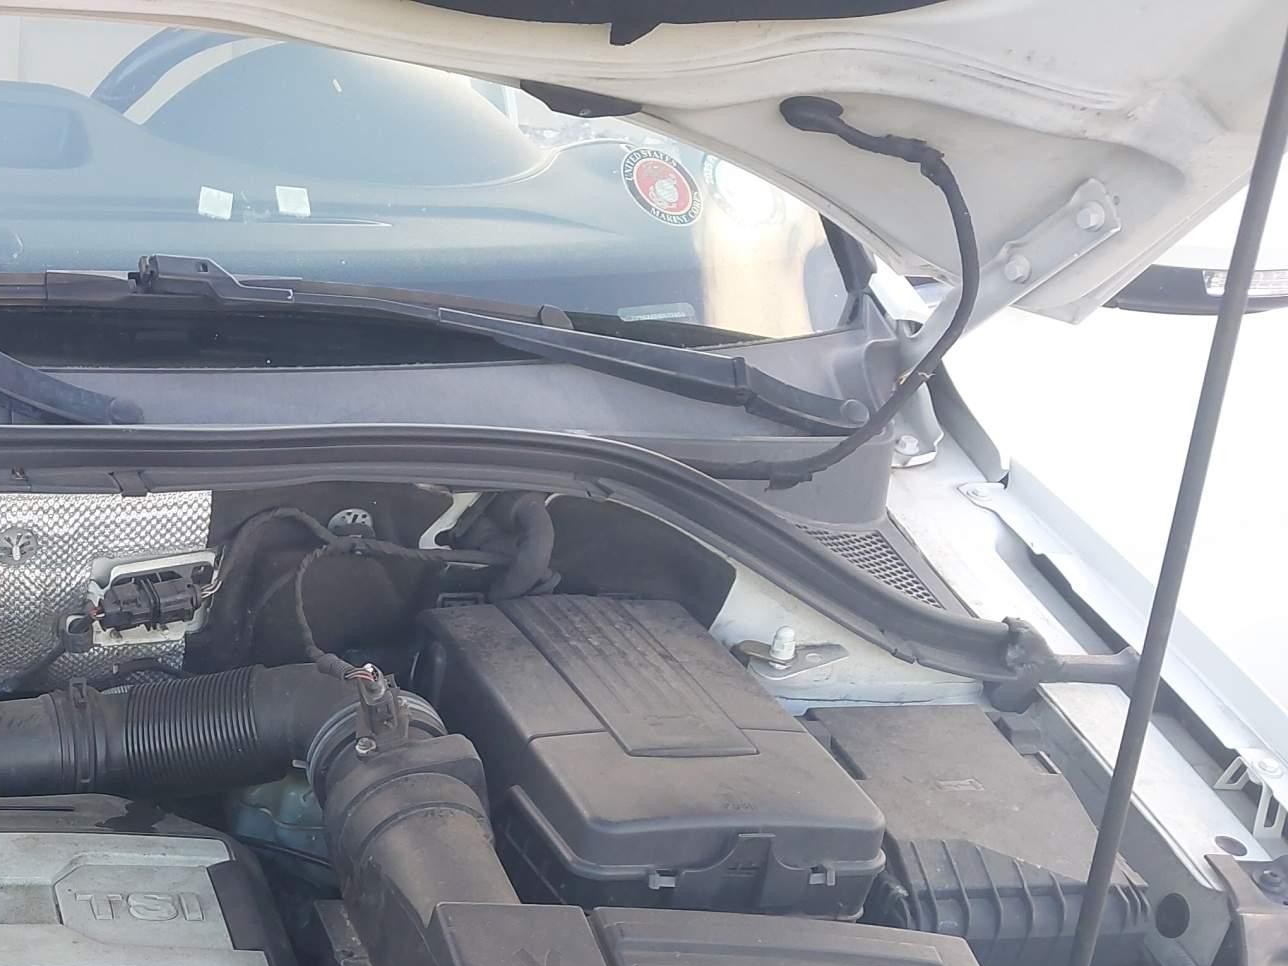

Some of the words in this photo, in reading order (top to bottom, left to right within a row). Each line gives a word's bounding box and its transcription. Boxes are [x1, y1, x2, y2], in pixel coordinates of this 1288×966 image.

[624, 152, 642, 181] UNITED
[650, 207, 688, 224] MARINE
[75, 891, 208, 921] TSI
